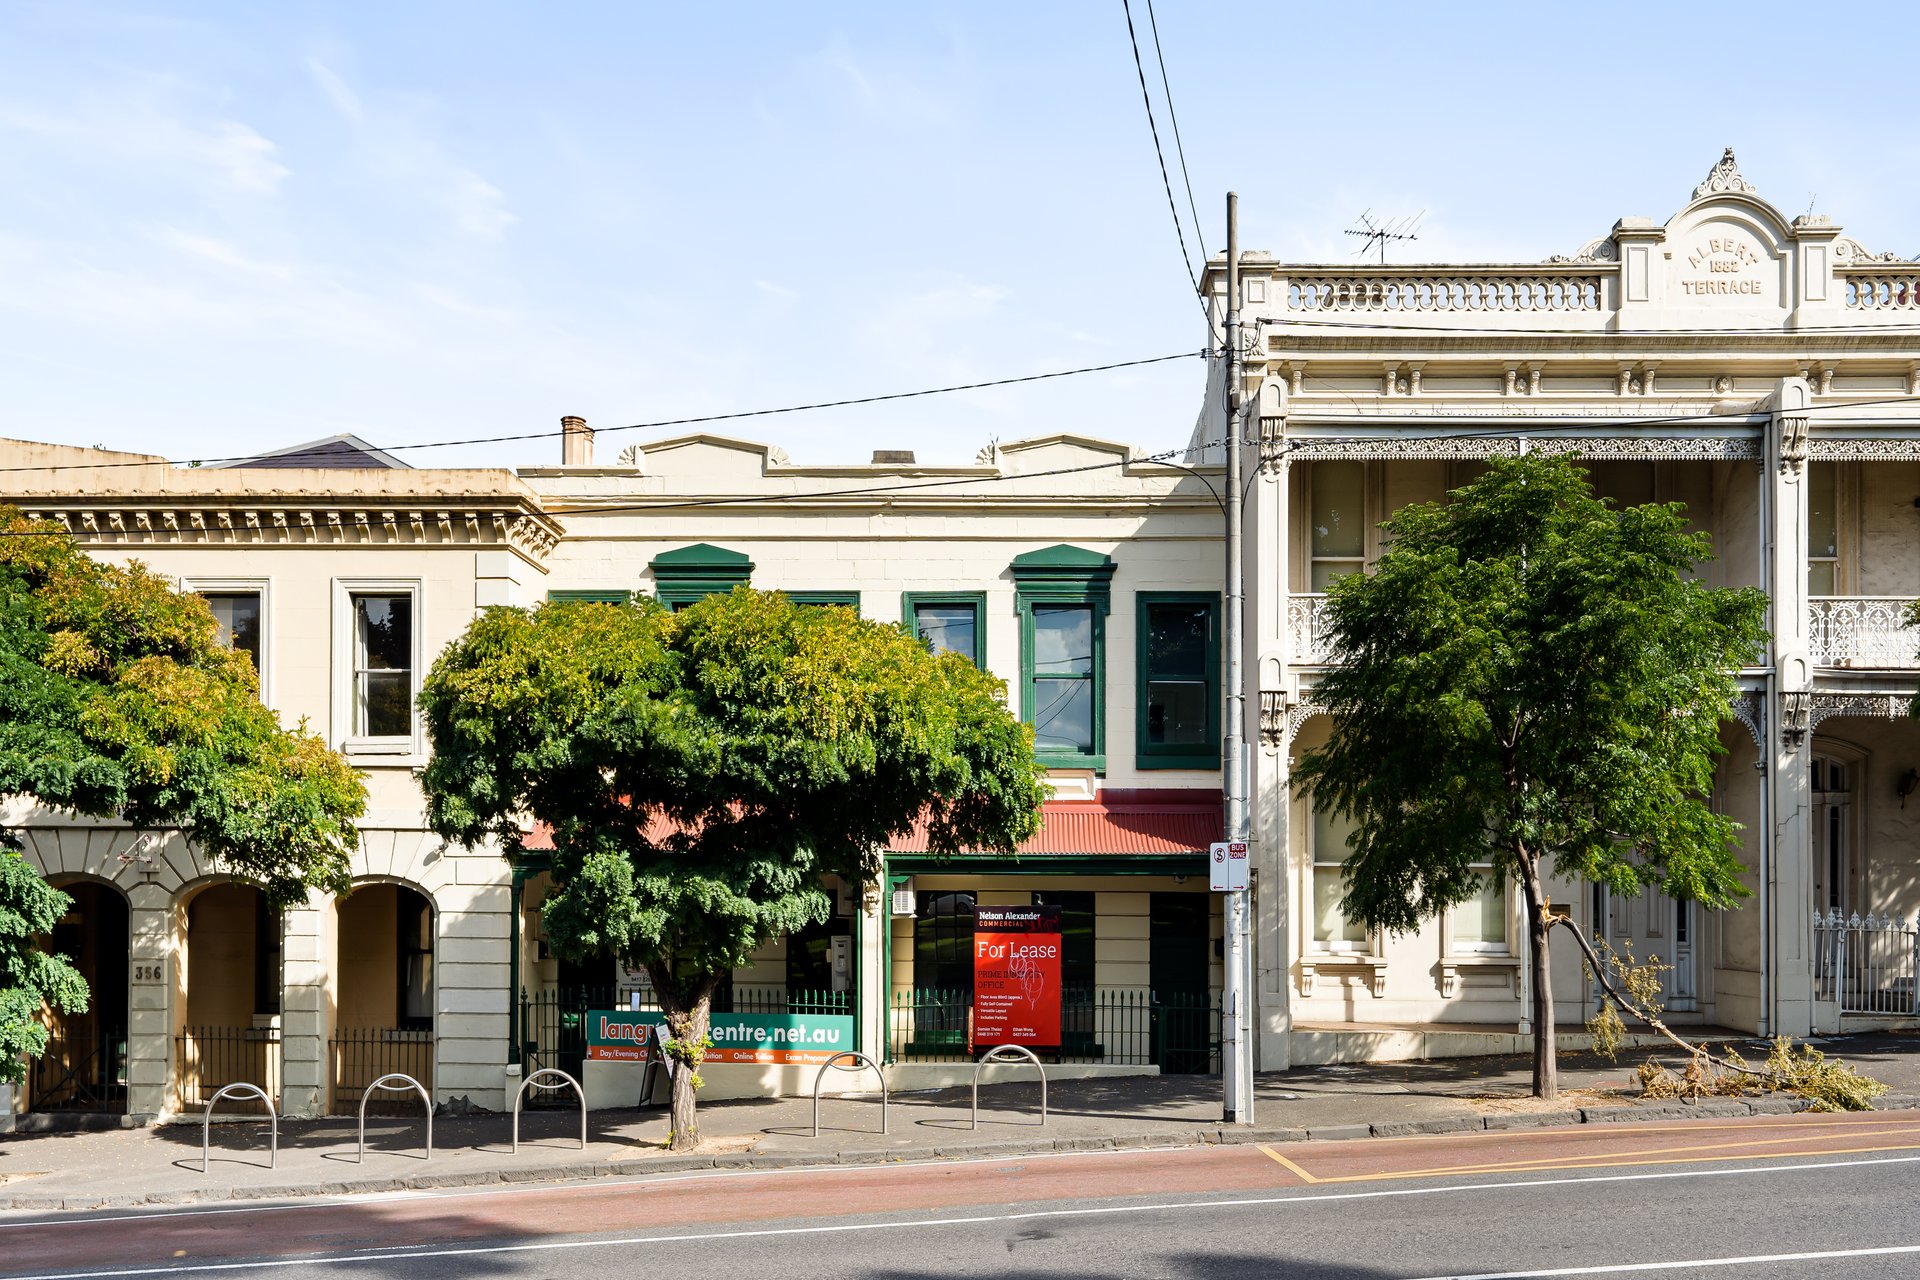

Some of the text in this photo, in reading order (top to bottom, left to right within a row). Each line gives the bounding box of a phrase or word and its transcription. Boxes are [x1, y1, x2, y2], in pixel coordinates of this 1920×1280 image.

[1688, 238, 1760, 269] ALBERT
[1710, 260, 1740, 273] 1882
[1682, 279, 1762, 295] TERRACE
[979, 911, 1041, 920] Nelson Alexander
[977, 941, 1057, 958] For Lease
[135, 966, 162, 980] 356
[977, 970, 1002, 979] PRIME
[977, 981, 1005, 989] OFFICE
[599, 1049, 639, 1060] Day/Evening
[733, 1052, 754, 1060] Online
[755, 1052, 775, 1061] Tuition
[785, 1053, 803, 1061] Exam
